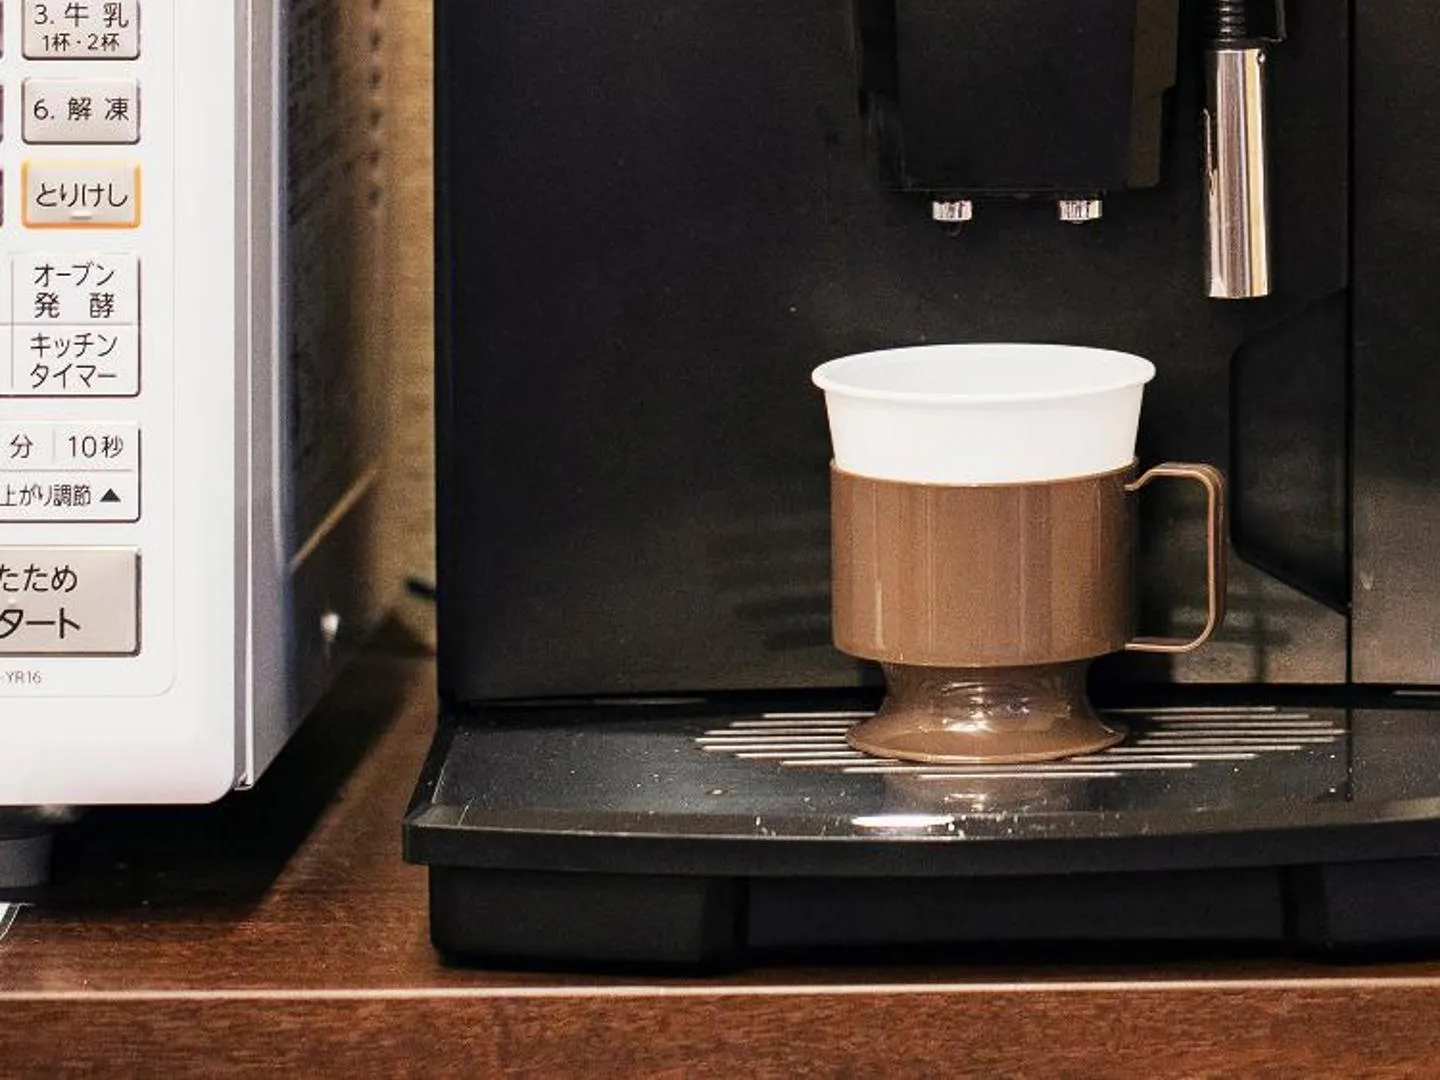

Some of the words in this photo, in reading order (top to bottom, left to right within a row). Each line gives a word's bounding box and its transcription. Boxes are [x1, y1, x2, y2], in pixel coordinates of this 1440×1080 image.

[36, 183, 128, 207] とりけし
[34, 260, 115, 287] オーブン
[30, 332, 118, 358] キッチン
[30, 363, 117, 389] タイマー
[10, 434, 33, 459] 分
[68, 434, 124, 459] 10秒
